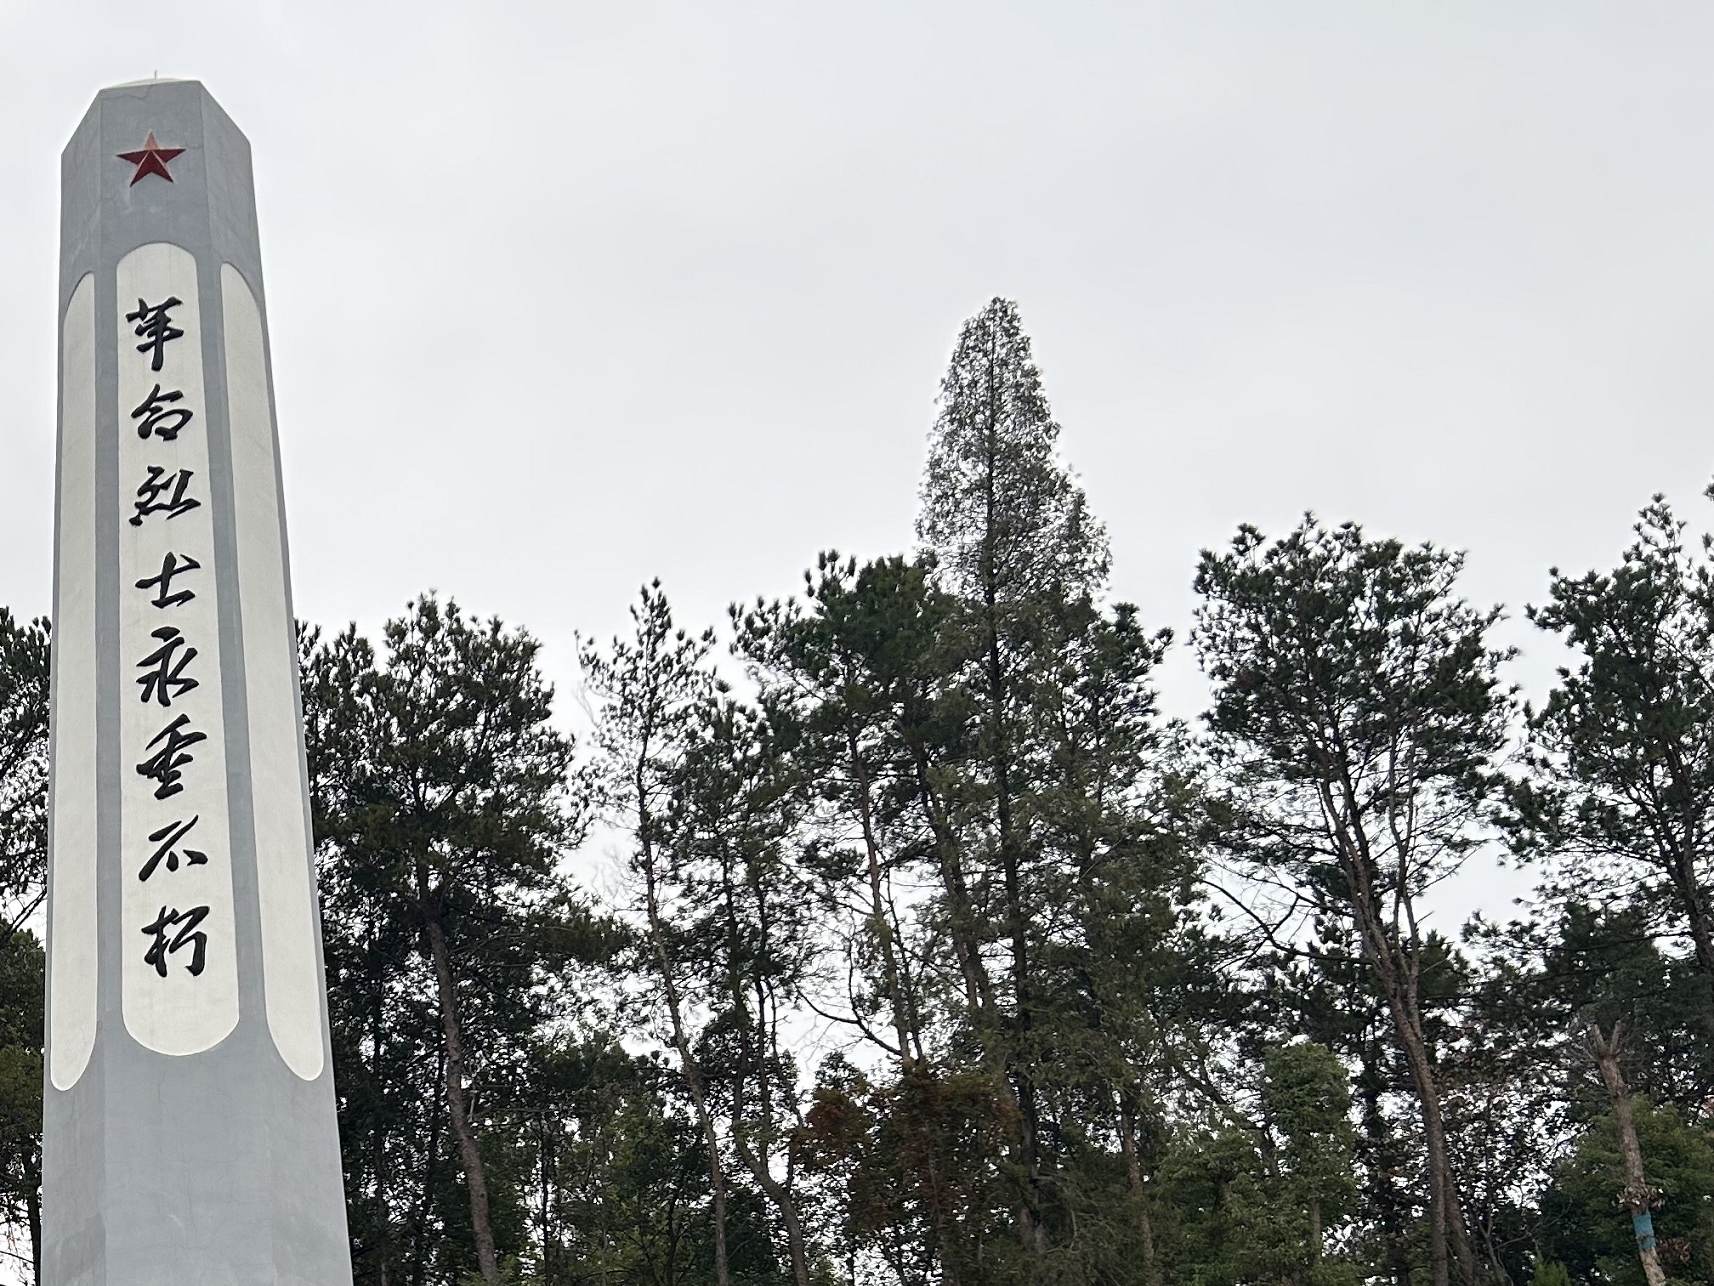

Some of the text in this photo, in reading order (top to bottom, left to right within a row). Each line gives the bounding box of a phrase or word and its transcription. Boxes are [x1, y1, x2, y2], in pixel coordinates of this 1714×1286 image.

[124, 295, 210, 978] 革命烈士永垂不朽
